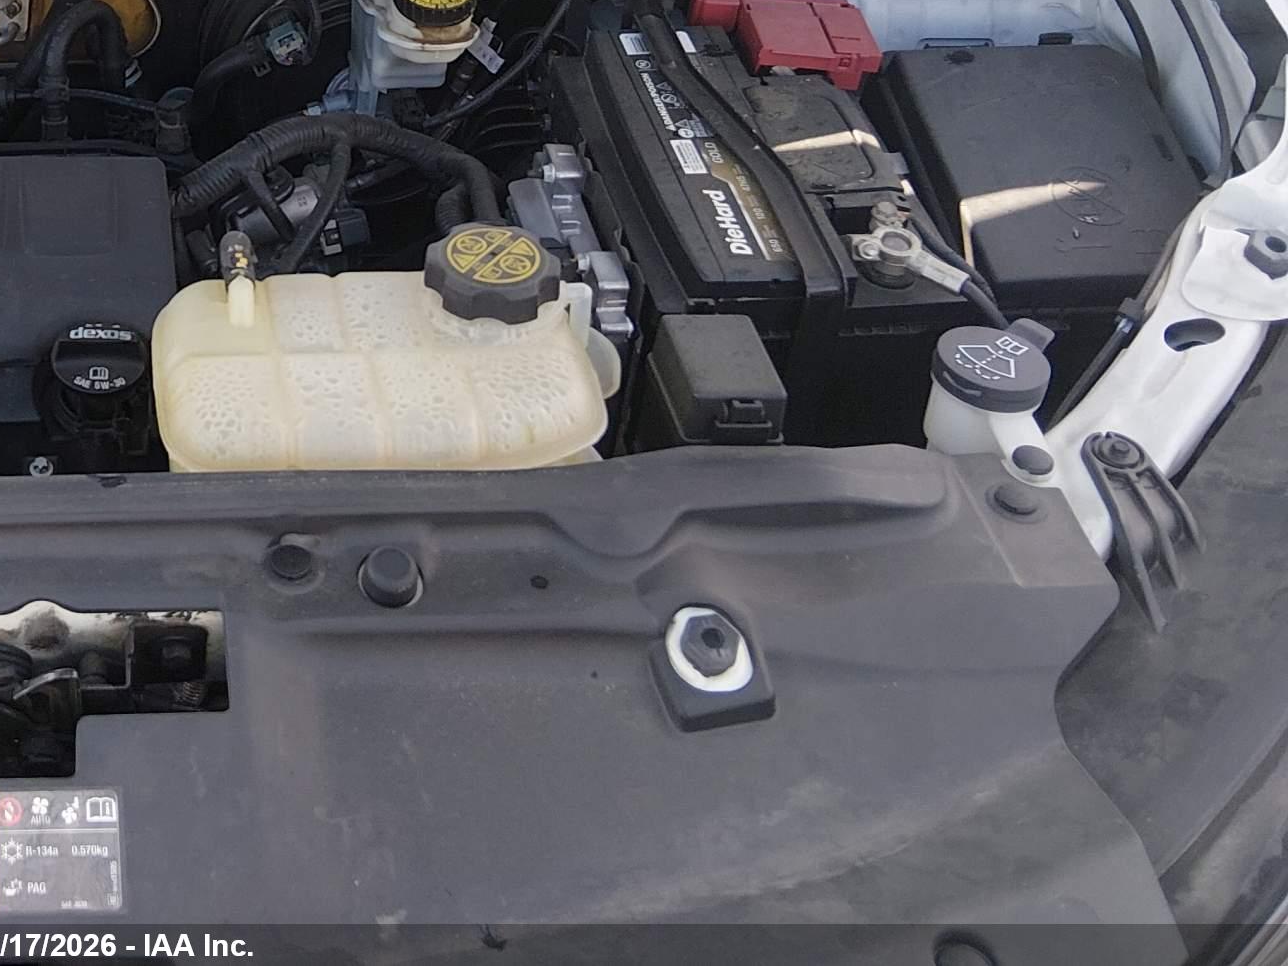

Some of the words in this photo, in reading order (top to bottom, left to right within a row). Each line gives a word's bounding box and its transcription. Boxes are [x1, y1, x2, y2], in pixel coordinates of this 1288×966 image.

[704, 142, 724, 163] GOLD
[702, 189, 753, 255] DieHard
[69, 326, 132, 341] dexos
[74, 376, 91, 389] SAE
[94, 377, 126, 390] 5W-30
[30, 815, 51, 825] AUTO
[25, 845, 59, 857] R-134a
[71, 845, 108, 858] 0.570kg
[27, 881, 47, 894] PAG
